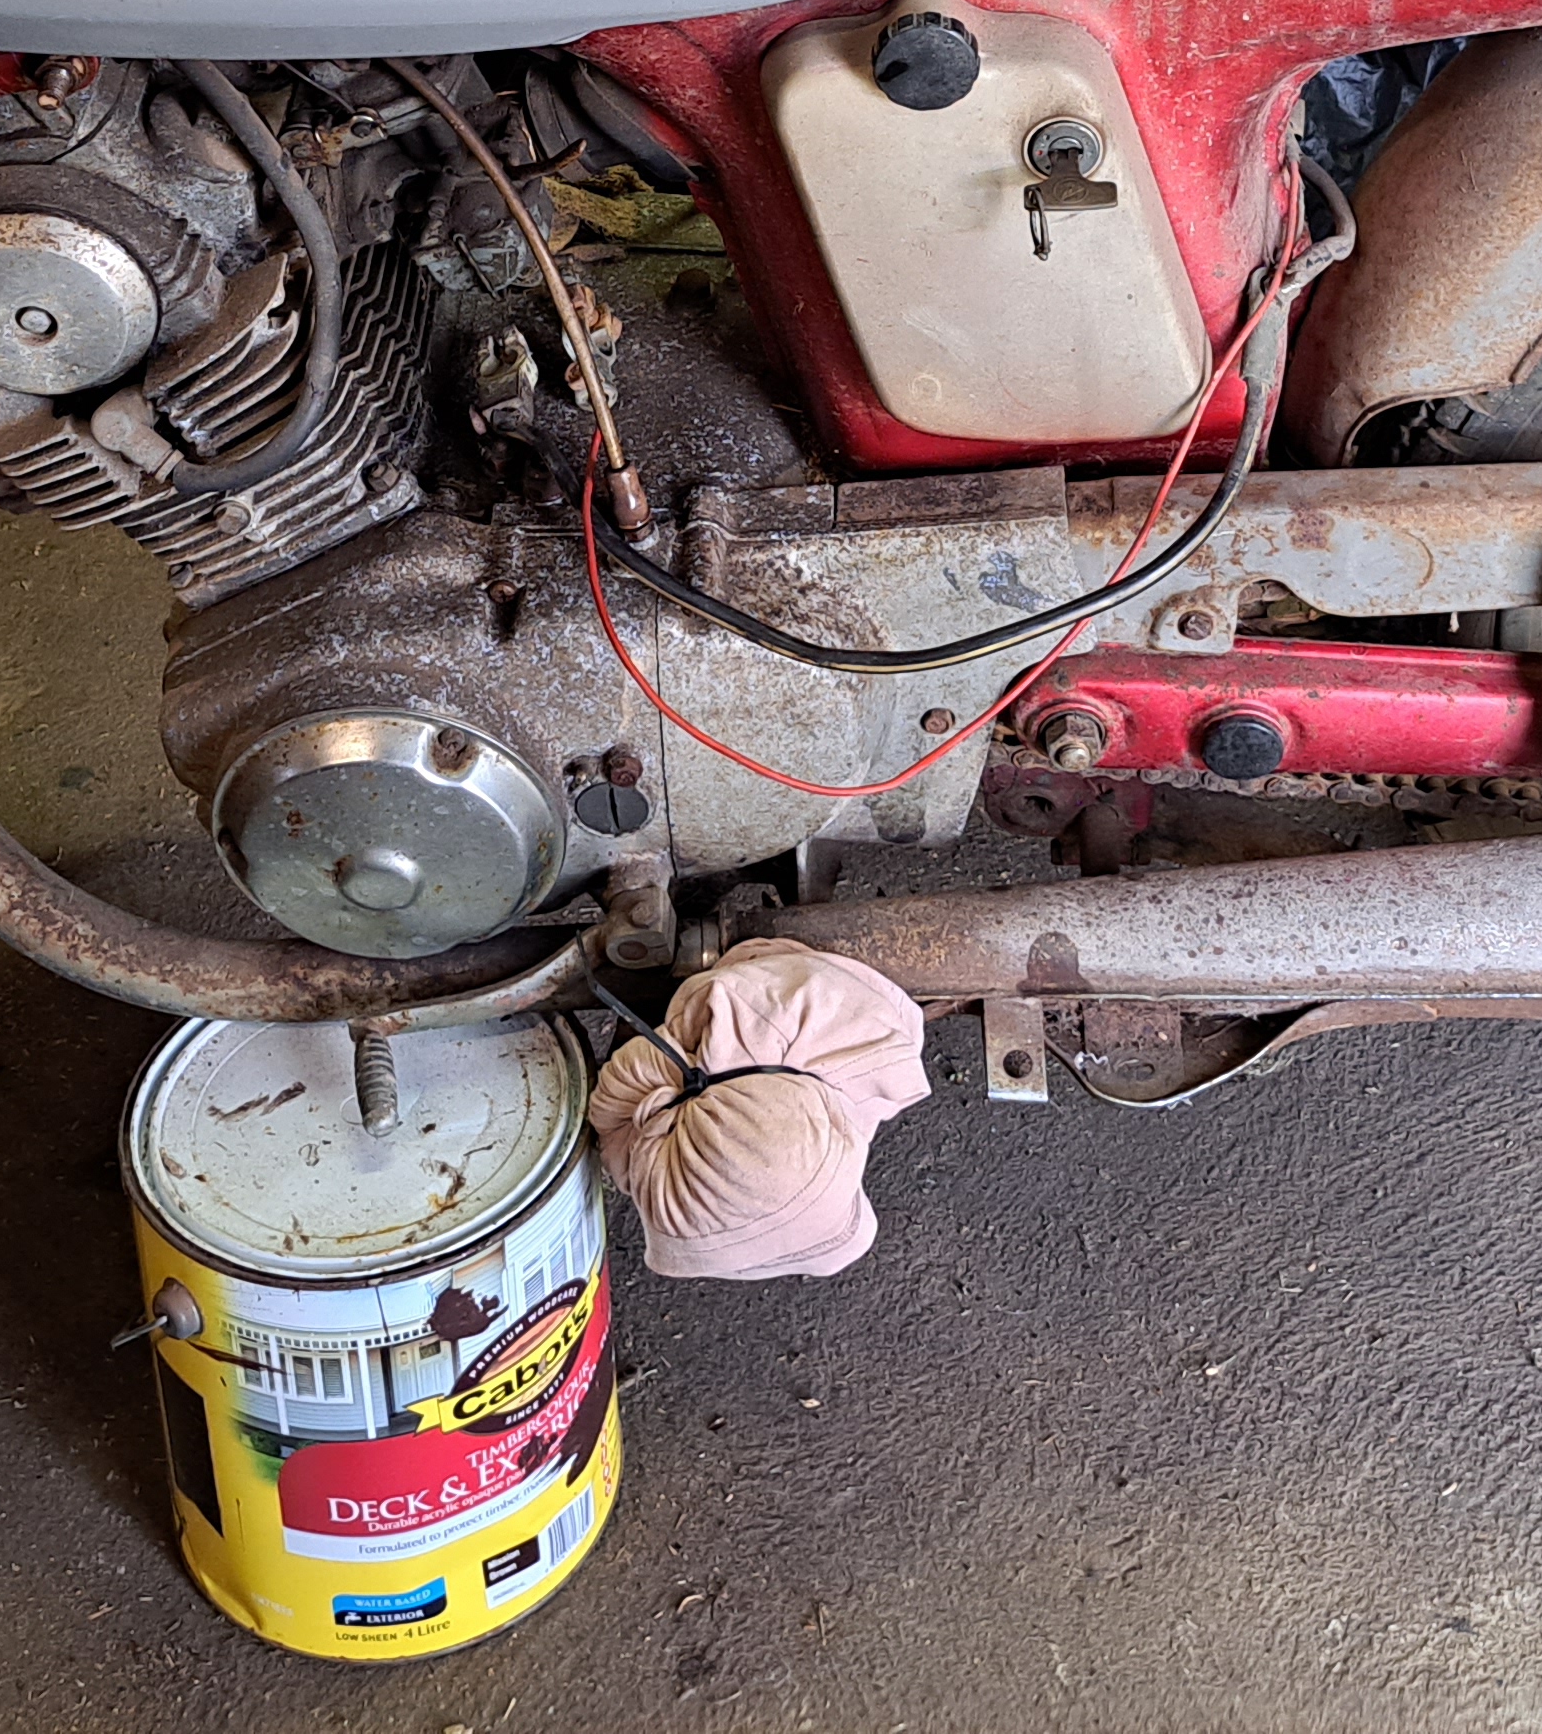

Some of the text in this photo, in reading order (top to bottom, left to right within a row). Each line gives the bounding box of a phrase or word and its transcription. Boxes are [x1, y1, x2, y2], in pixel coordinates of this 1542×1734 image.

[468, 1286, 578, 1379] PREMIUM WOODCARE
[452, 1302, 590, 1420] Cabot's
[505, 1401, 540, 1425] SINCE
[326, 1489, 434, 1523] DECK
[439, 1475, 472, 1504] &
[367, 1515, 419, 1533] Durable
[421, 1501, 460, 1526] acrylic
[461, 1482, 504, 1510] opaque
[359, 1536, 427, 1555] Formulated
[429, 1531, 441, 1542] to
[443, 1514, 483, 1539] protect
[354, 1588, 431, 1608] WATER BASED
[366, 1609, 425, 1624] EXTERIOR
[335, 1620, 451, 1642] LOW SHEEN 4 Litre
